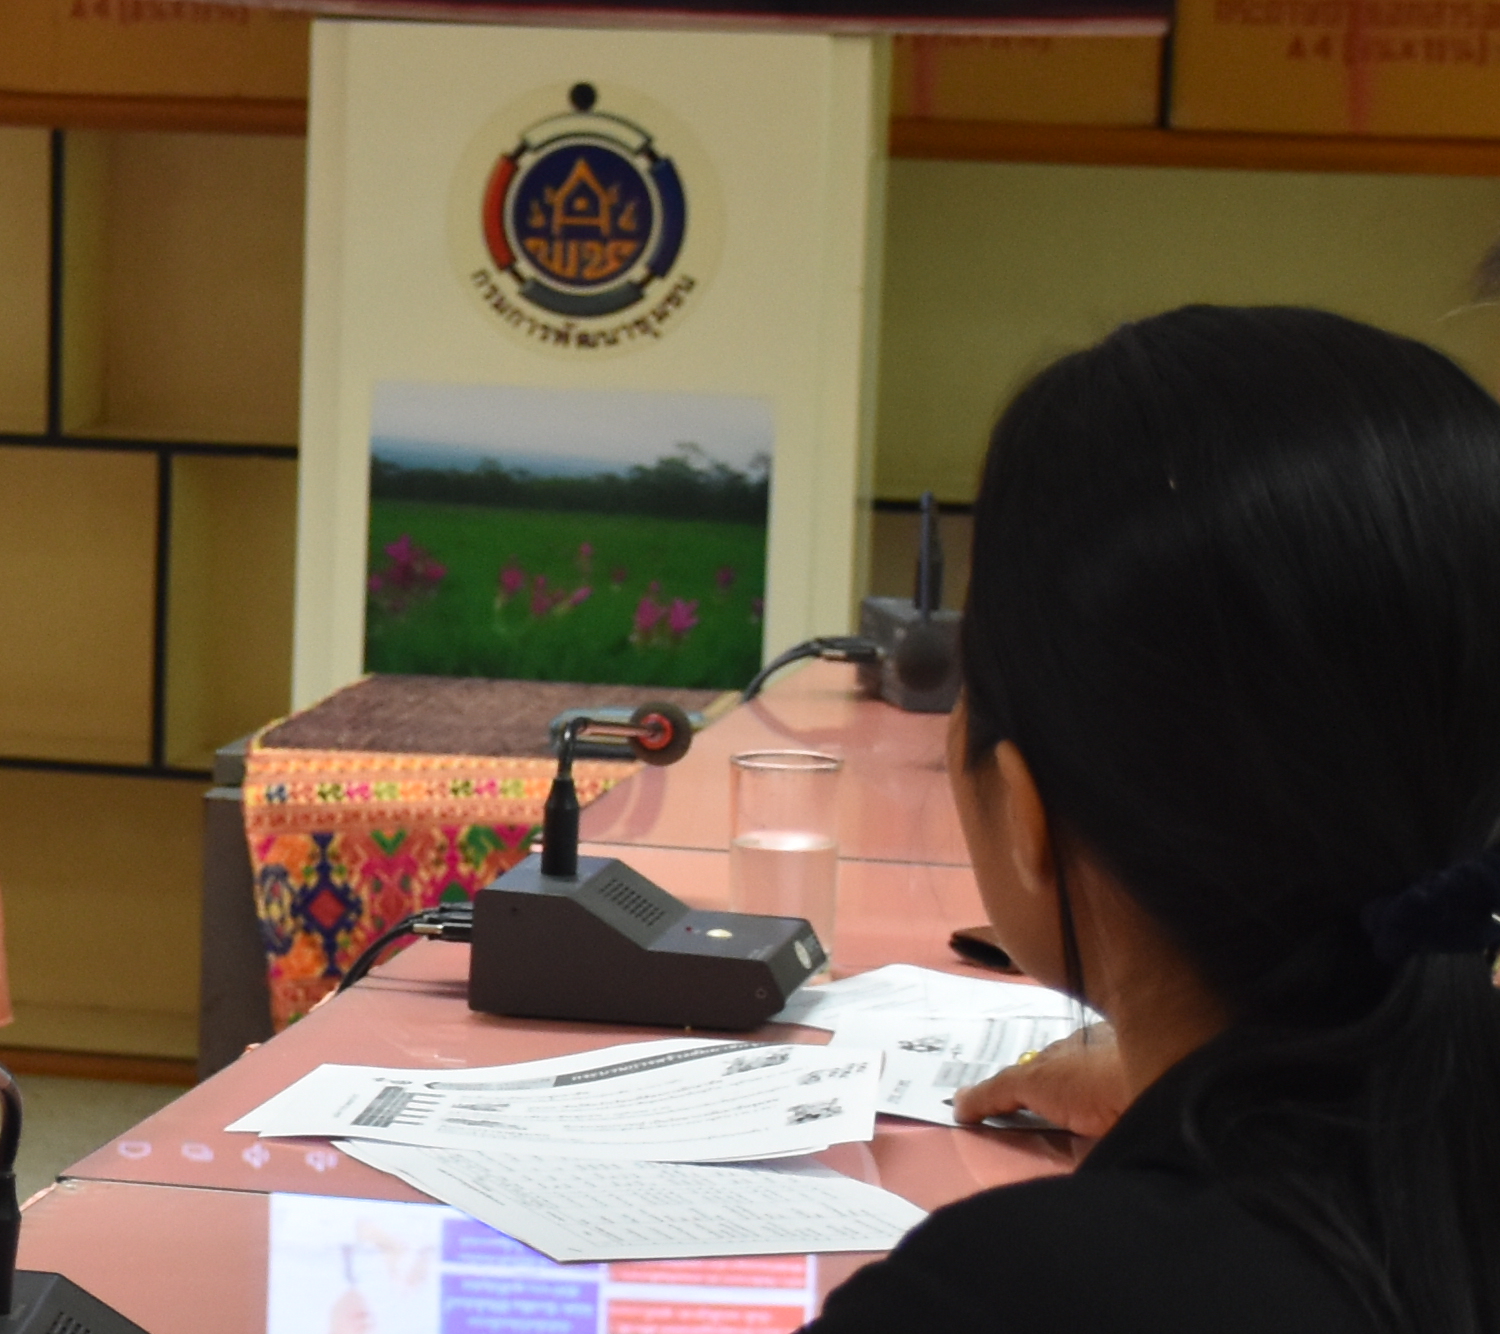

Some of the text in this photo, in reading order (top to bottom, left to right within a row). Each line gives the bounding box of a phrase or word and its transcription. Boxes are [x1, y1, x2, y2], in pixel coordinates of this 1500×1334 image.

[471, 267, 695, 350] กรมการพัฒนาชุมชน
